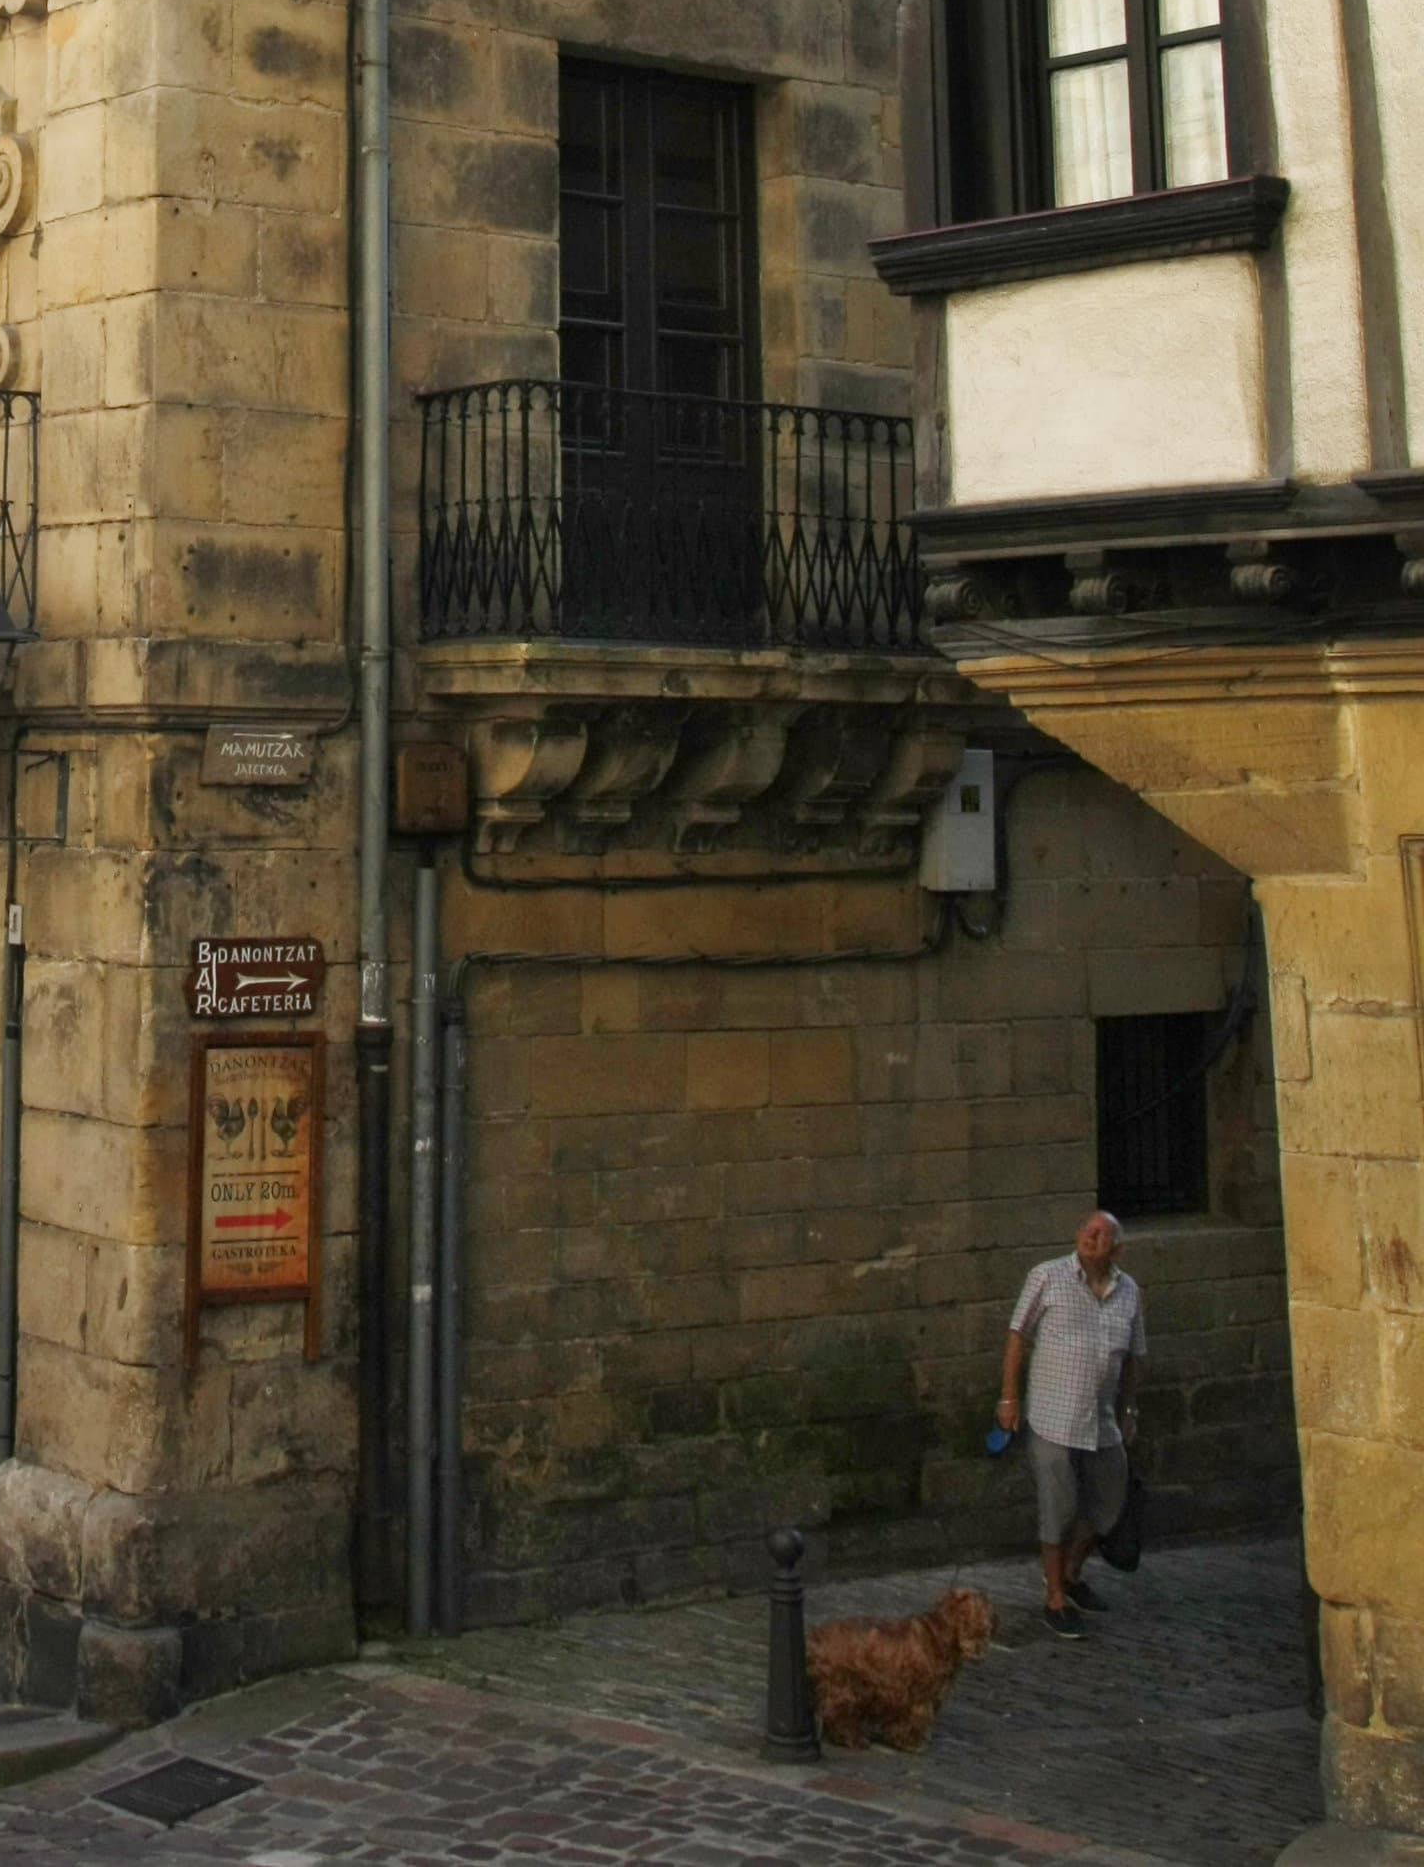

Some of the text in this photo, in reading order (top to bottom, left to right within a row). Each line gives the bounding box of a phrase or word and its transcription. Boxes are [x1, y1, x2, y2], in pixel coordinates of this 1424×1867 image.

[220, 742, 304, 758] MAMUTZAR
[217, 945, 317, 964] DANONTZAT
[211, 1182, 255, 1203] ONLY
[212, 1244, 296, 1260] GASTROTEKA
